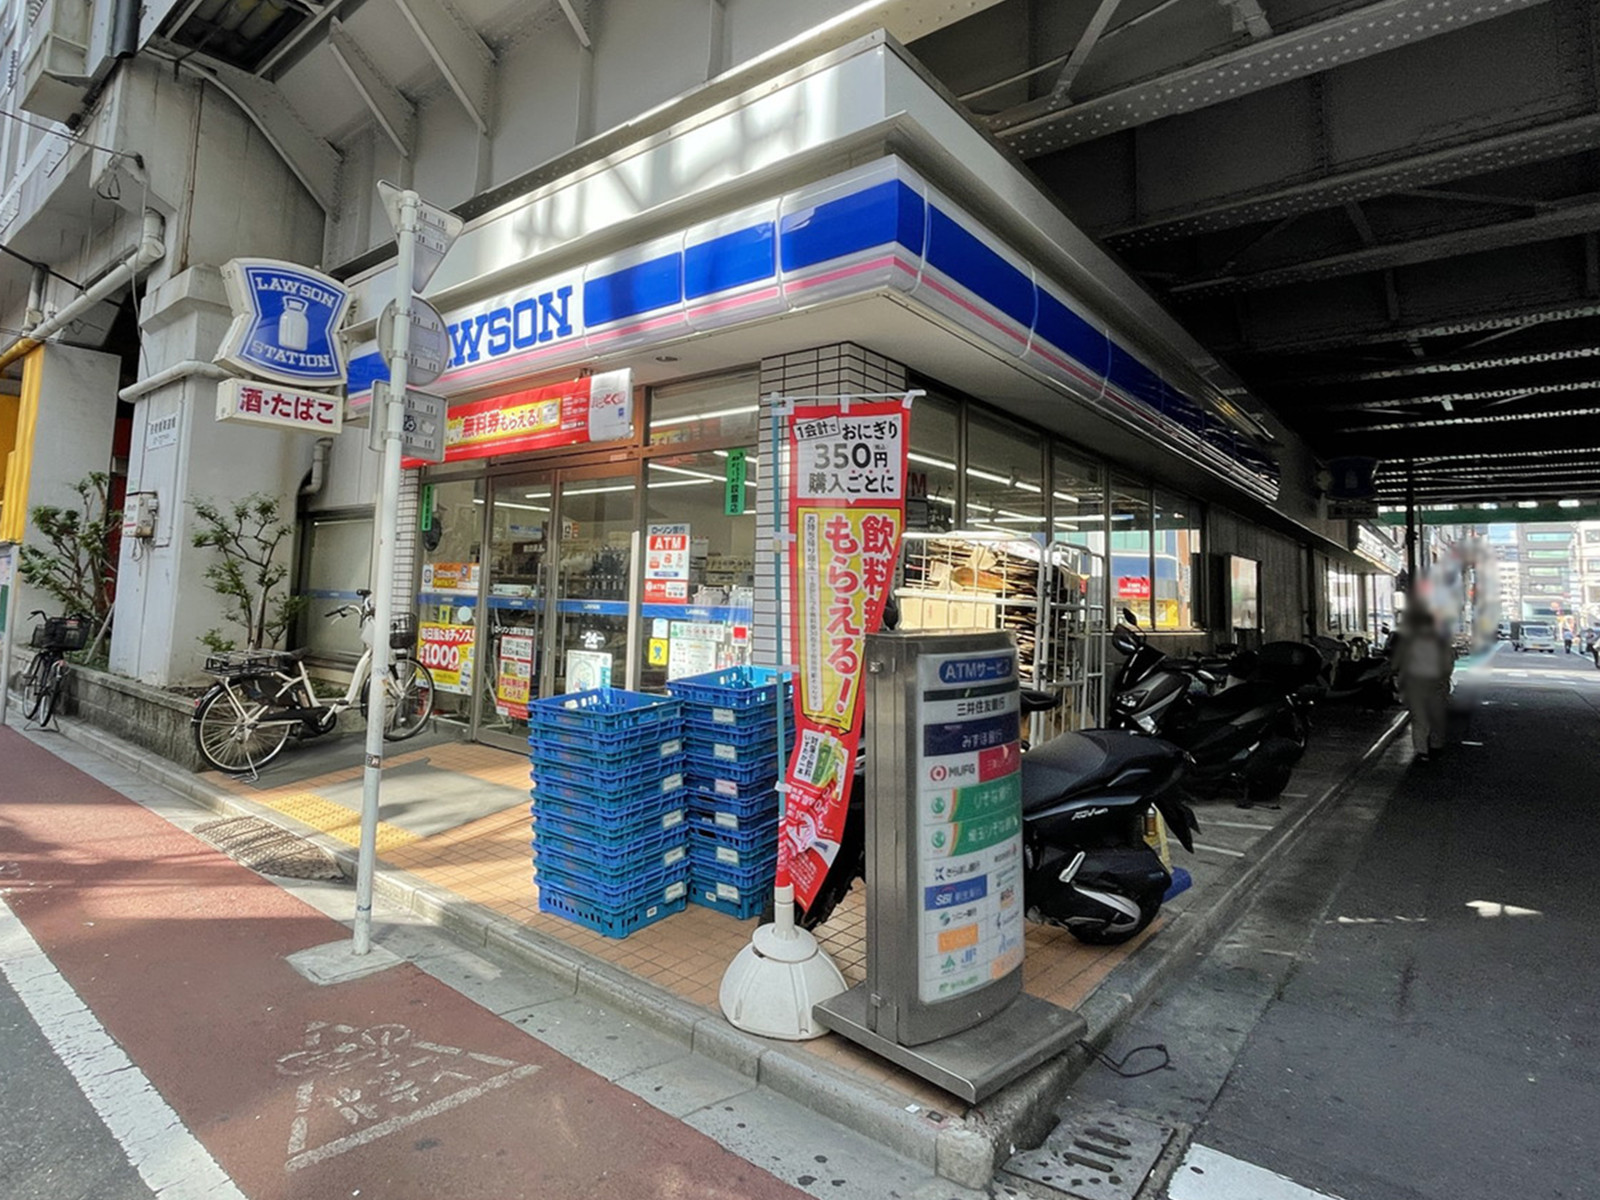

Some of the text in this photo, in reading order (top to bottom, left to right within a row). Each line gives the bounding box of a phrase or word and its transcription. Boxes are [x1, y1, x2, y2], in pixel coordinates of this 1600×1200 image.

[256, 276, 336, 309] LAWSON
[447, 285, 573, 369] WSON
[250, 340, 332, 369] STATION
[240, 387, 334, 425] 酒・たばこ
[842, 420, 898, 441] おにぎり
[814, 443, 889, 470] 350円
[808, 472, 895, 494] 購入ごとに
[651, 526, 686, 535] ローソン銀行
[655, 537, 681, 550] ATM
[825, 515, 861, 714] もらえる!
[957, 698, 1006, 716] 三井住友銀行
[962, 730, 1003, 748] みずほ銀行
[948, 763, 976, 778] MUFG
